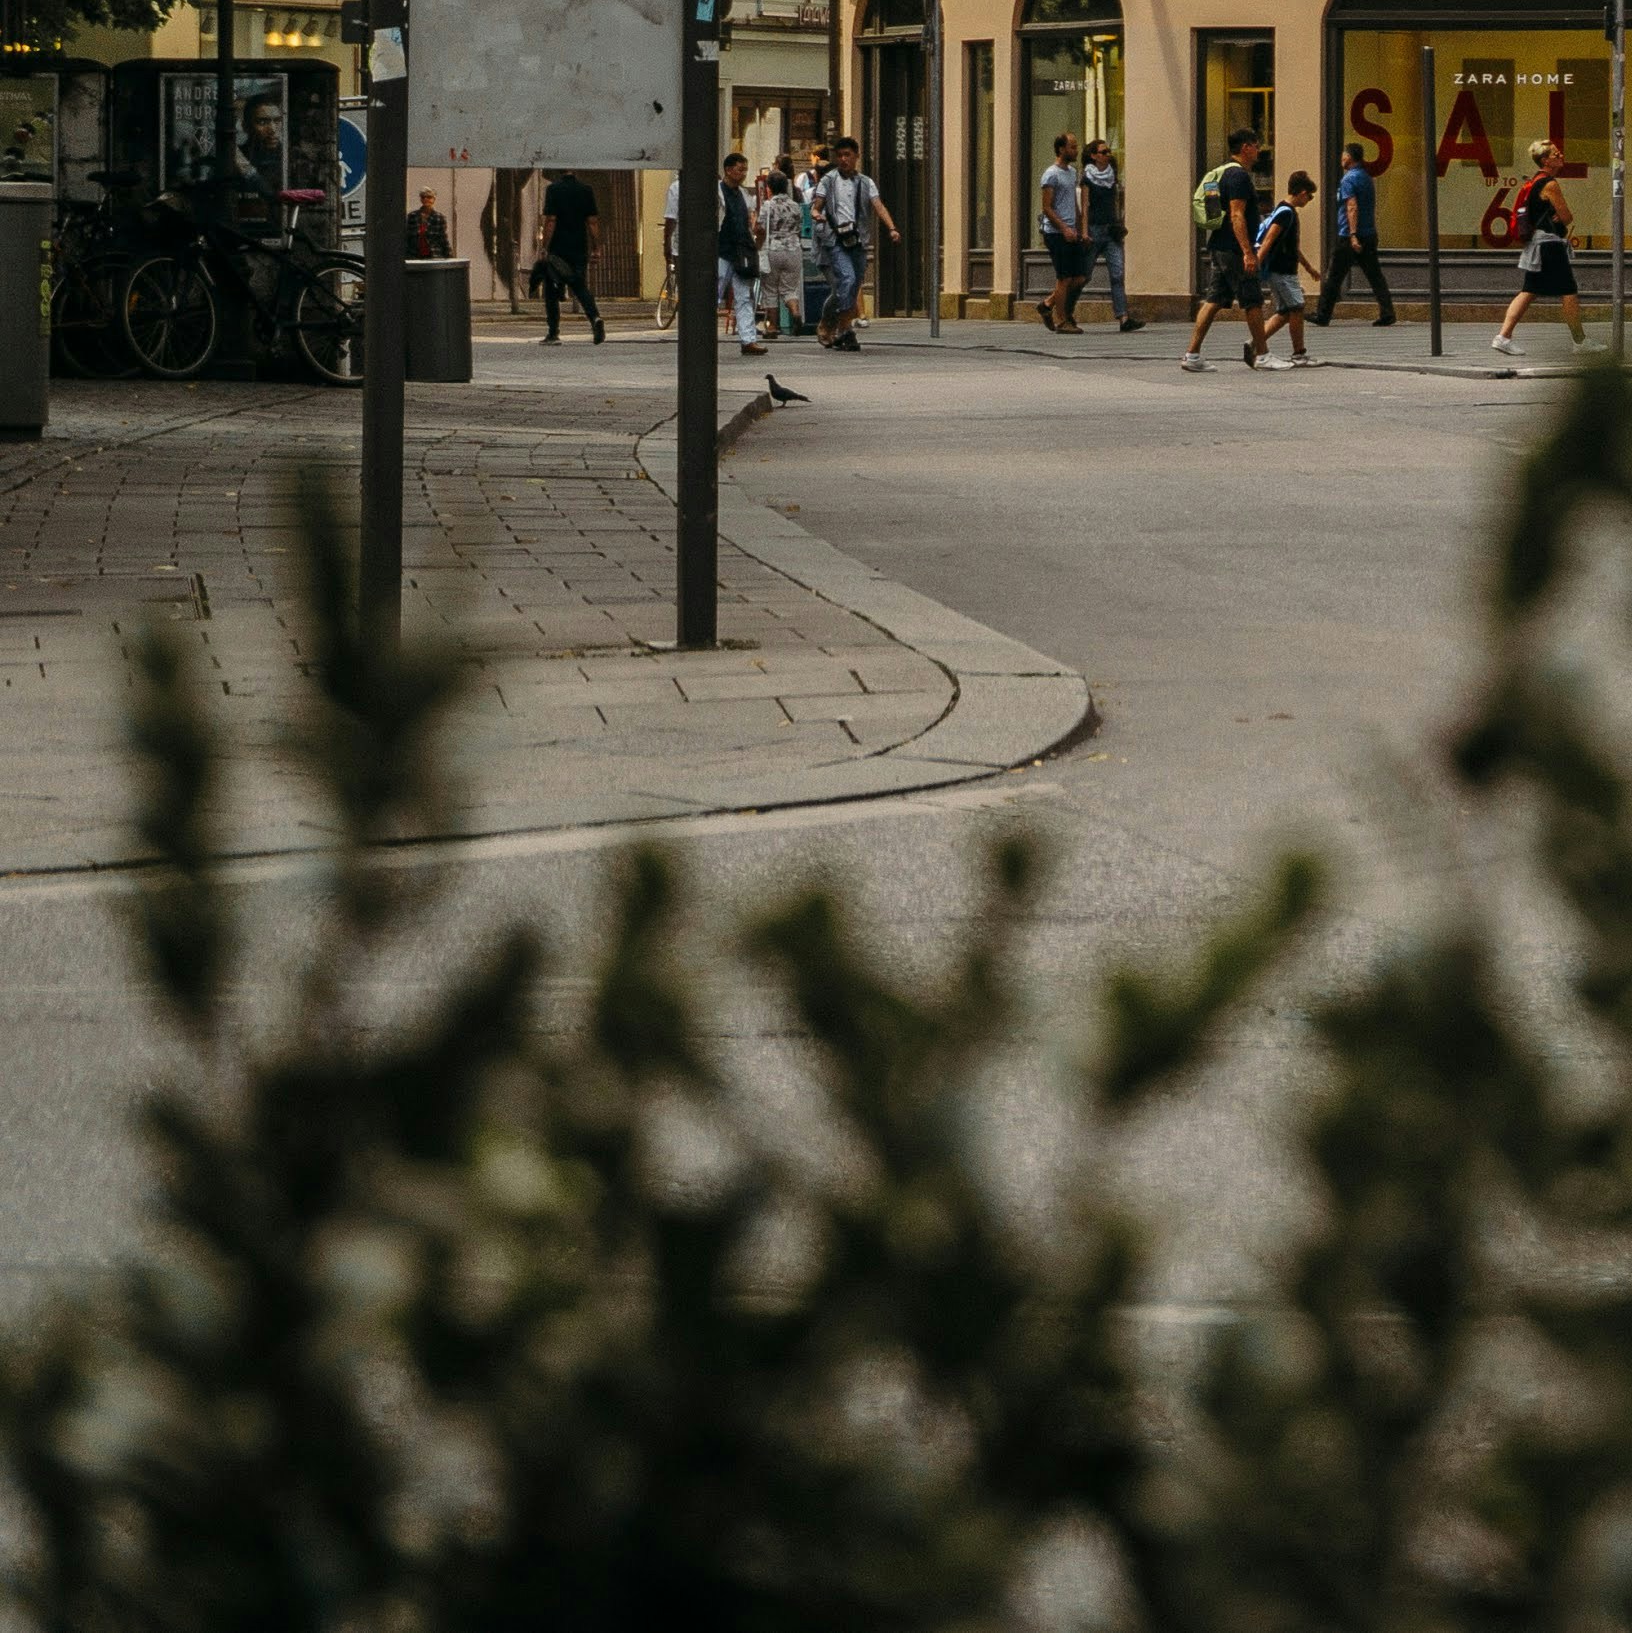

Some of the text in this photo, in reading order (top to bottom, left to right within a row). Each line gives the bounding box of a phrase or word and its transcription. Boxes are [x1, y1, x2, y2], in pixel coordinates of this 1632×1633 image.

[1454, 73, 1575, 84] ZARA HOME
[1485, 177, 1518, 188] UP TO
